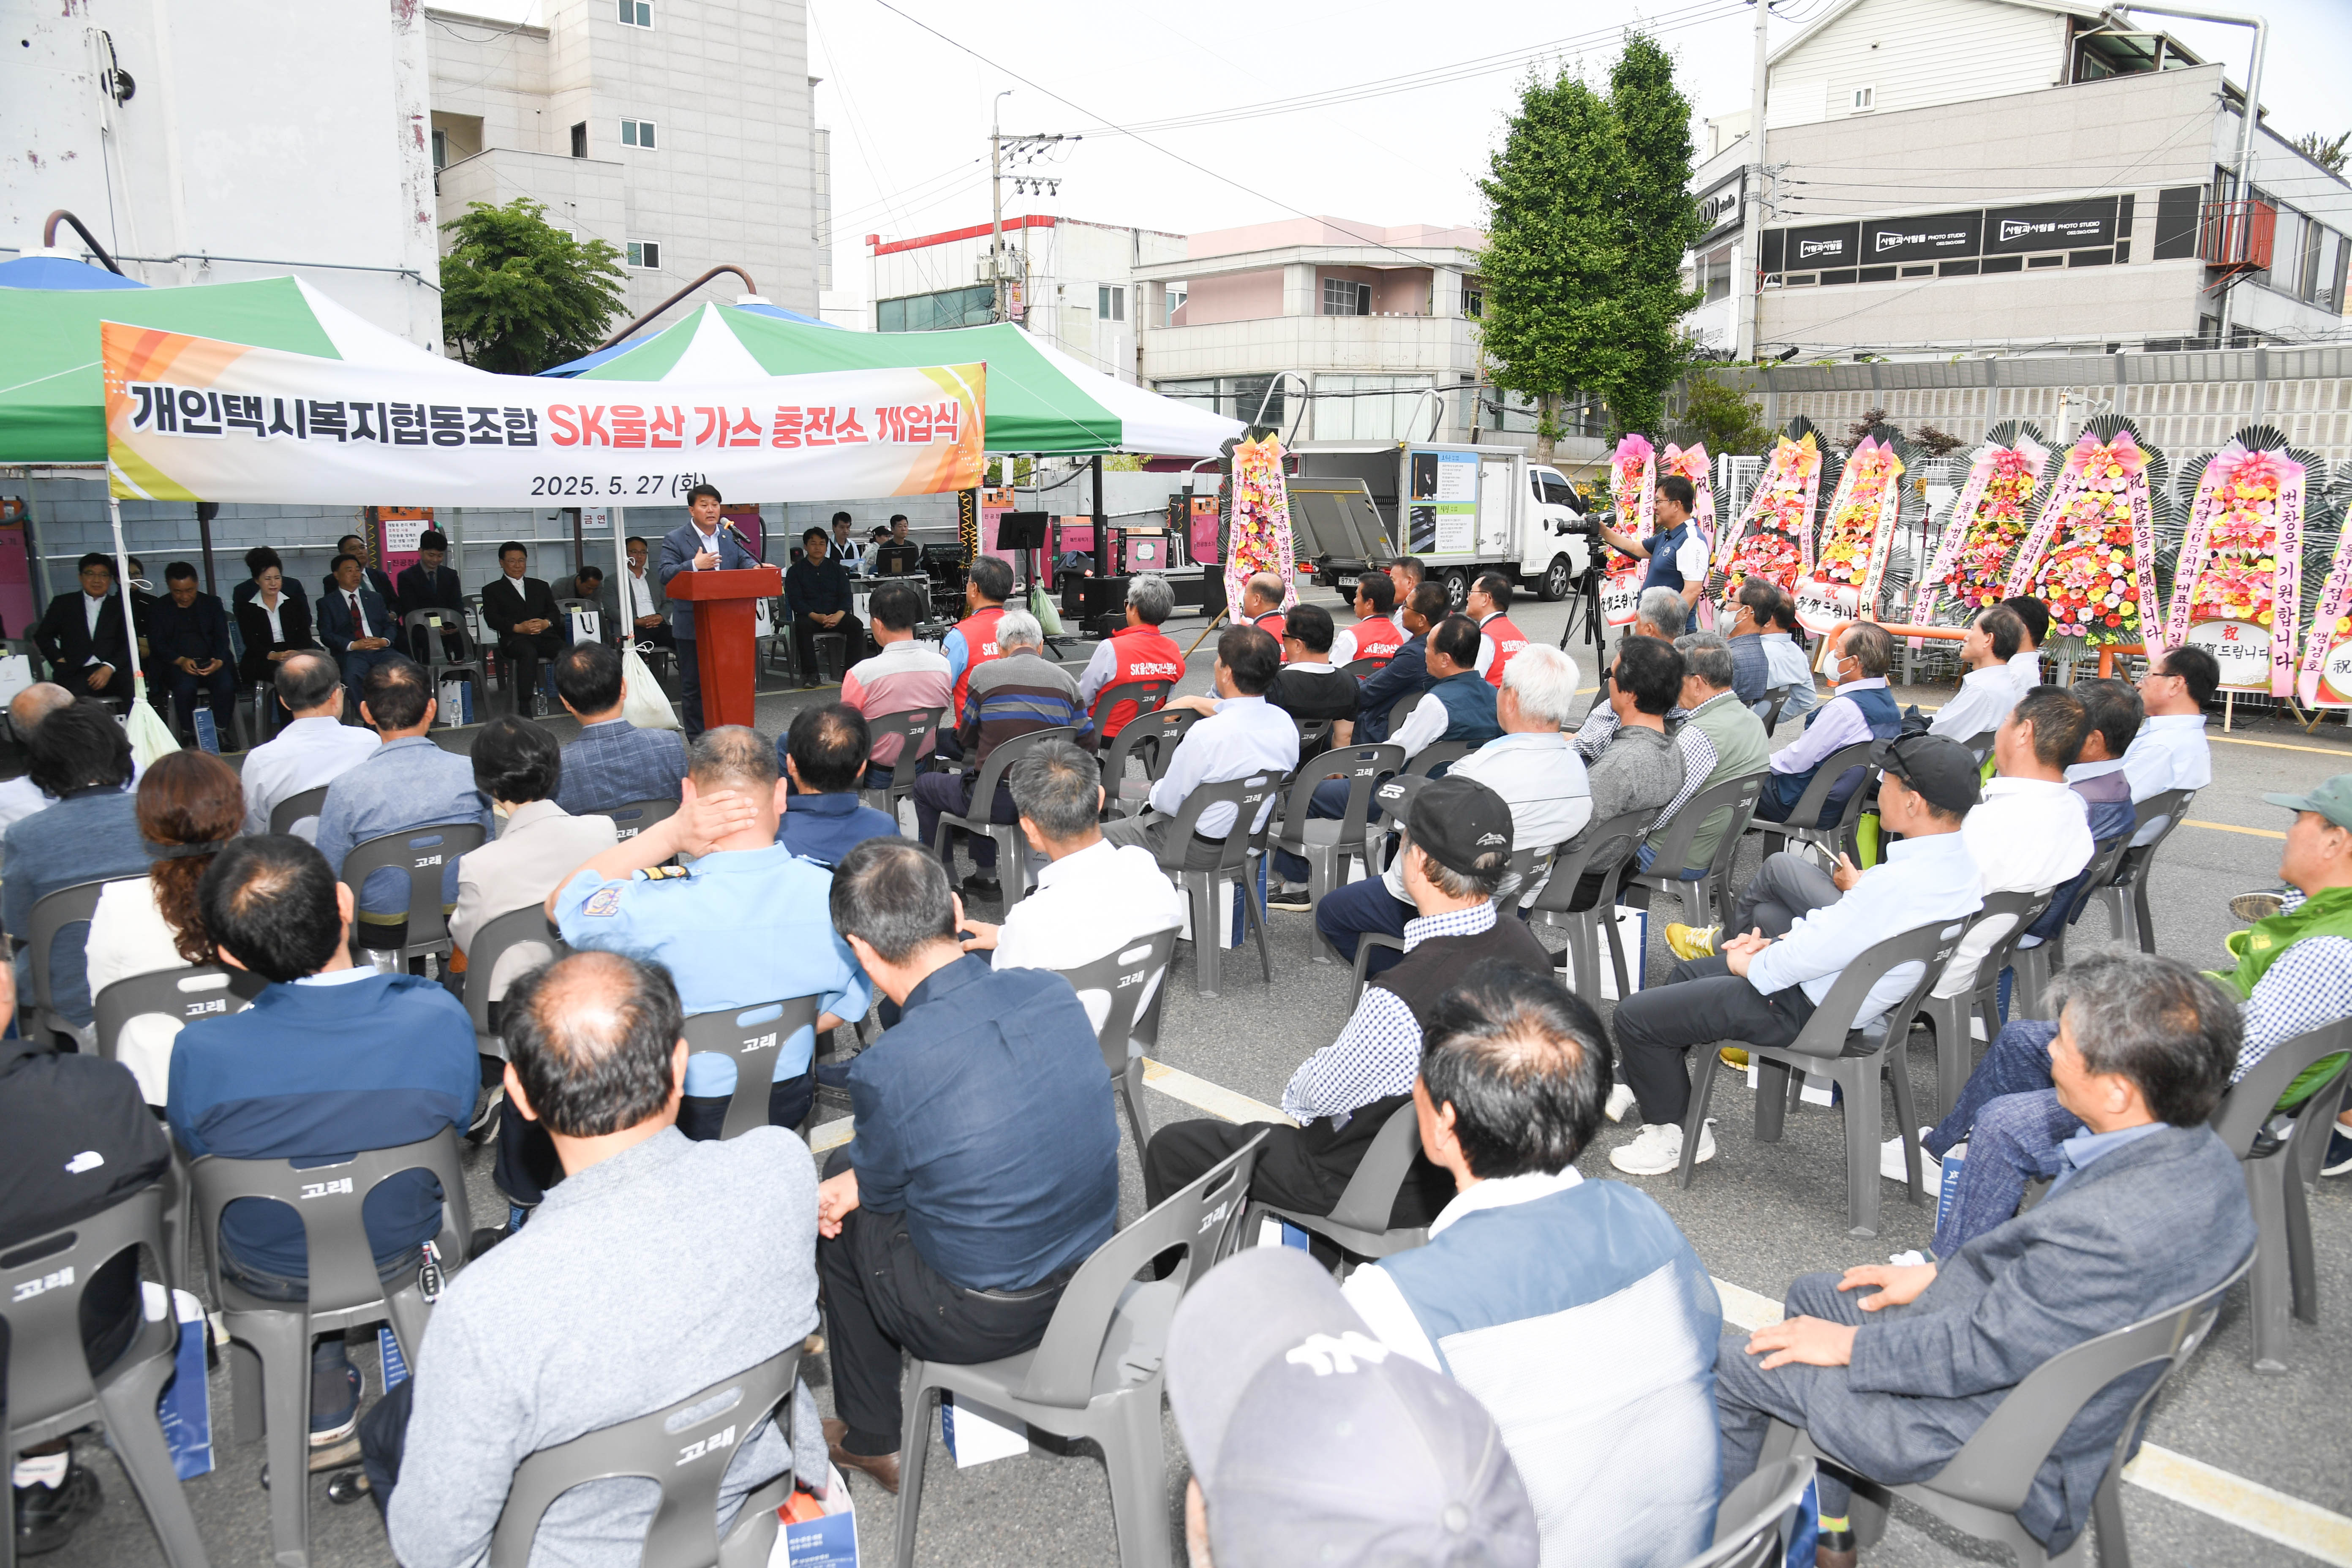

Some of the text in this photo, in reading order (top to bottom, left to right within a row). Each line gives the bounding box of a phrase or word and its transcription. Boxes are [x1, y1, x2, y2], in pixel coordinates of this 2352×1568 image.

[2005, 223, 2055, 234] 사람과사람들
[1804, 243, 1842, 252] 사람과사람들
[1881, 234, 1926, 245] 사람과사람들
[131, 386, 960, 449] 개인택시복지협동조합 SK울산 가스 충전소 개업식
[531, 476, 600, 496] 2025.
[609, 475, 628, 495] 5.
[636, 475, 662, 495] 27
[1696, 476, 1710, 494] 祝
[2129, 472, 2146, 491] 祝
[1643, 468, 1654, 517] 진심으로
[584, 514, 606, 525] 금연
[1944, 501, 1973, 552] 울산병원
[2178, 486, 2215, 578] 디지털365치과
[1279, 536, 1292, 565] 발전을
[1862, 496, 1895, 615] 개소를 축하합니다
[392, 558, 419, 567] 진공청
[1282, 567, 1296, 604] 기원합니
[1615, 576, 1626, 591] 祝
[2006, 566, 2028, 597] 부회장
[2273, 488, 2300, 671] 번창을 기원합니다
[1823, 584, 1841, 600] 祝
[2168, 583, 2191, 629] 대표원장
[2220, 624, 2239, 641] 祝
[983, 642, 999, 656] SK울
[2303, 632, 2328, 672] 맹경호
[909, 727, 924, 735] 고래
[1162, 729, 1178, 737] 고래
[1355, 768, 1374, 776] 고래
[1243, 794, 1262, 803] 고래
[1379, 783, 1406, 799] 03
[1739, 798, 1752, 807] 고래
[617, 827, 639, 838] 고래
[1636, 827, 1648, 837] 고래
[415, 855, 442, 868] 고래
[1529, 863, 1546, 874] 고래
[2026, 903, 2045, 915] 고래
[1933, 947, 1954, 963] 고래
[1117, 970, 1144, 988] 고래
[186, 999, 226, 1015] 고래
[741, 1032, 776, 1053] 고래
[301, 1177, 354, 1199] 고래
[1198, 1200, 1228, 1235] 고래
[13, 1266, 74, 1302] 고래
[675, 1425, 735, 1466] 고래
